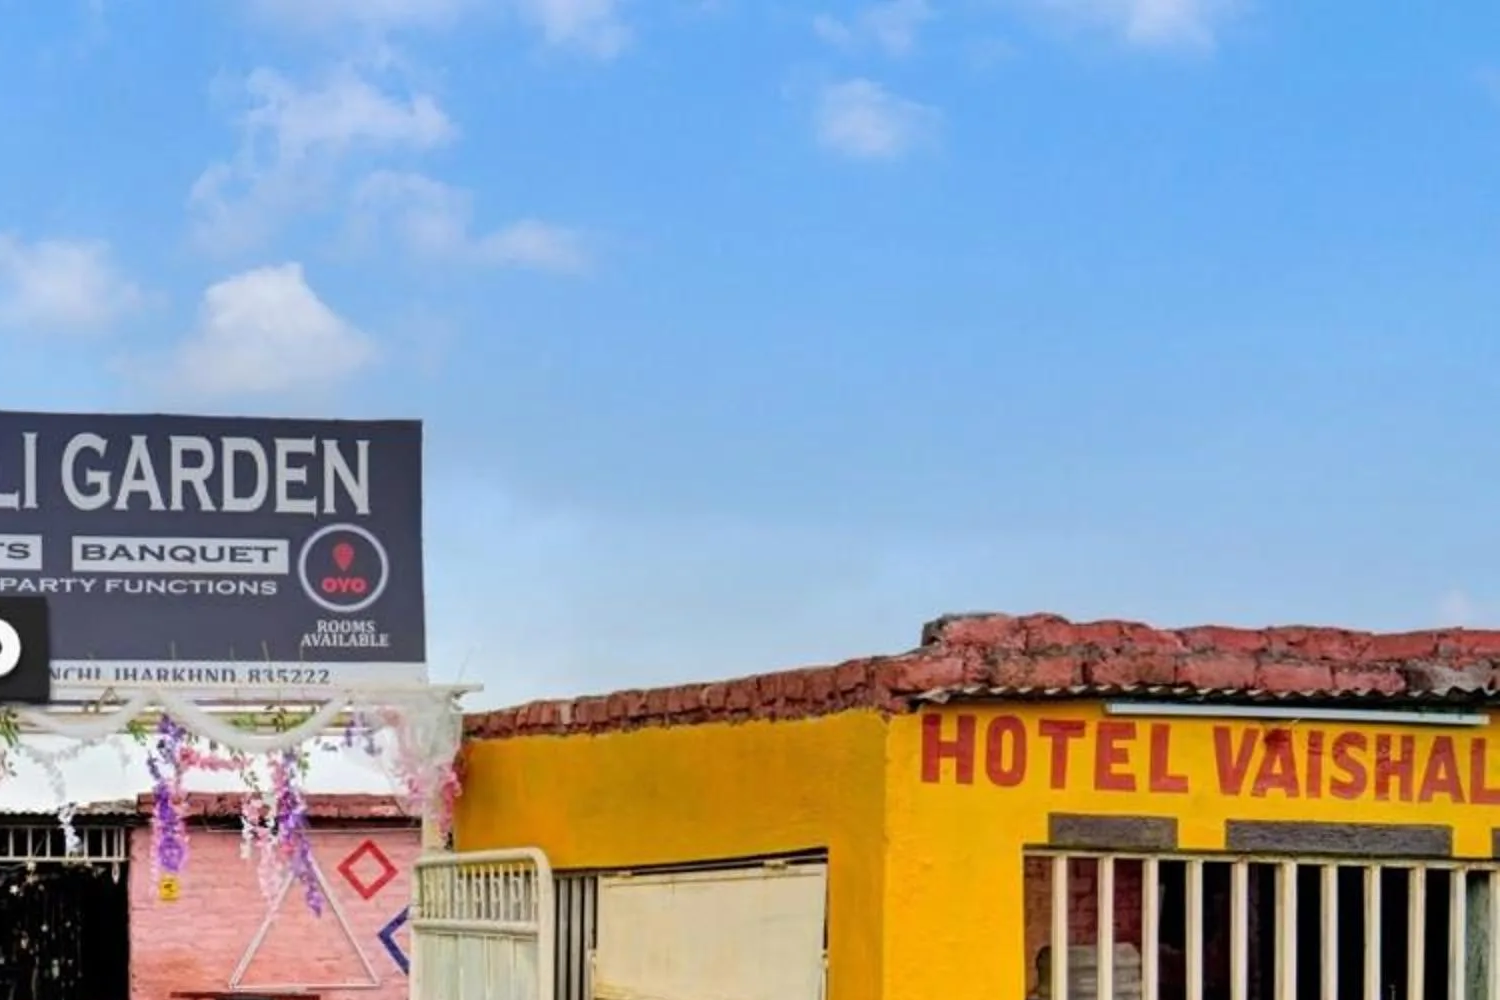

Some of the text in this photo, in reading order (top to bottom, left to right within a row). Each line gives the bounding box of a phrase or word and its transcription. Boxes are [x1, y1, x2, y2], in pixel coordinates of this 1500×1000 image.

[61, 432, 370, 516] GARDEN
[81, 543, 278, 563] BANQUET
[0, 577, 97, 594] PARTY
[105, 579, 277, 595] FUNCTIONS
[322, 577, 367, 593] OYO
[317, 619, 376, 634] ROOMS
[301, 633, 389, 647] AVAILABLE
[920, 713, 1189, 794] HOTEL
